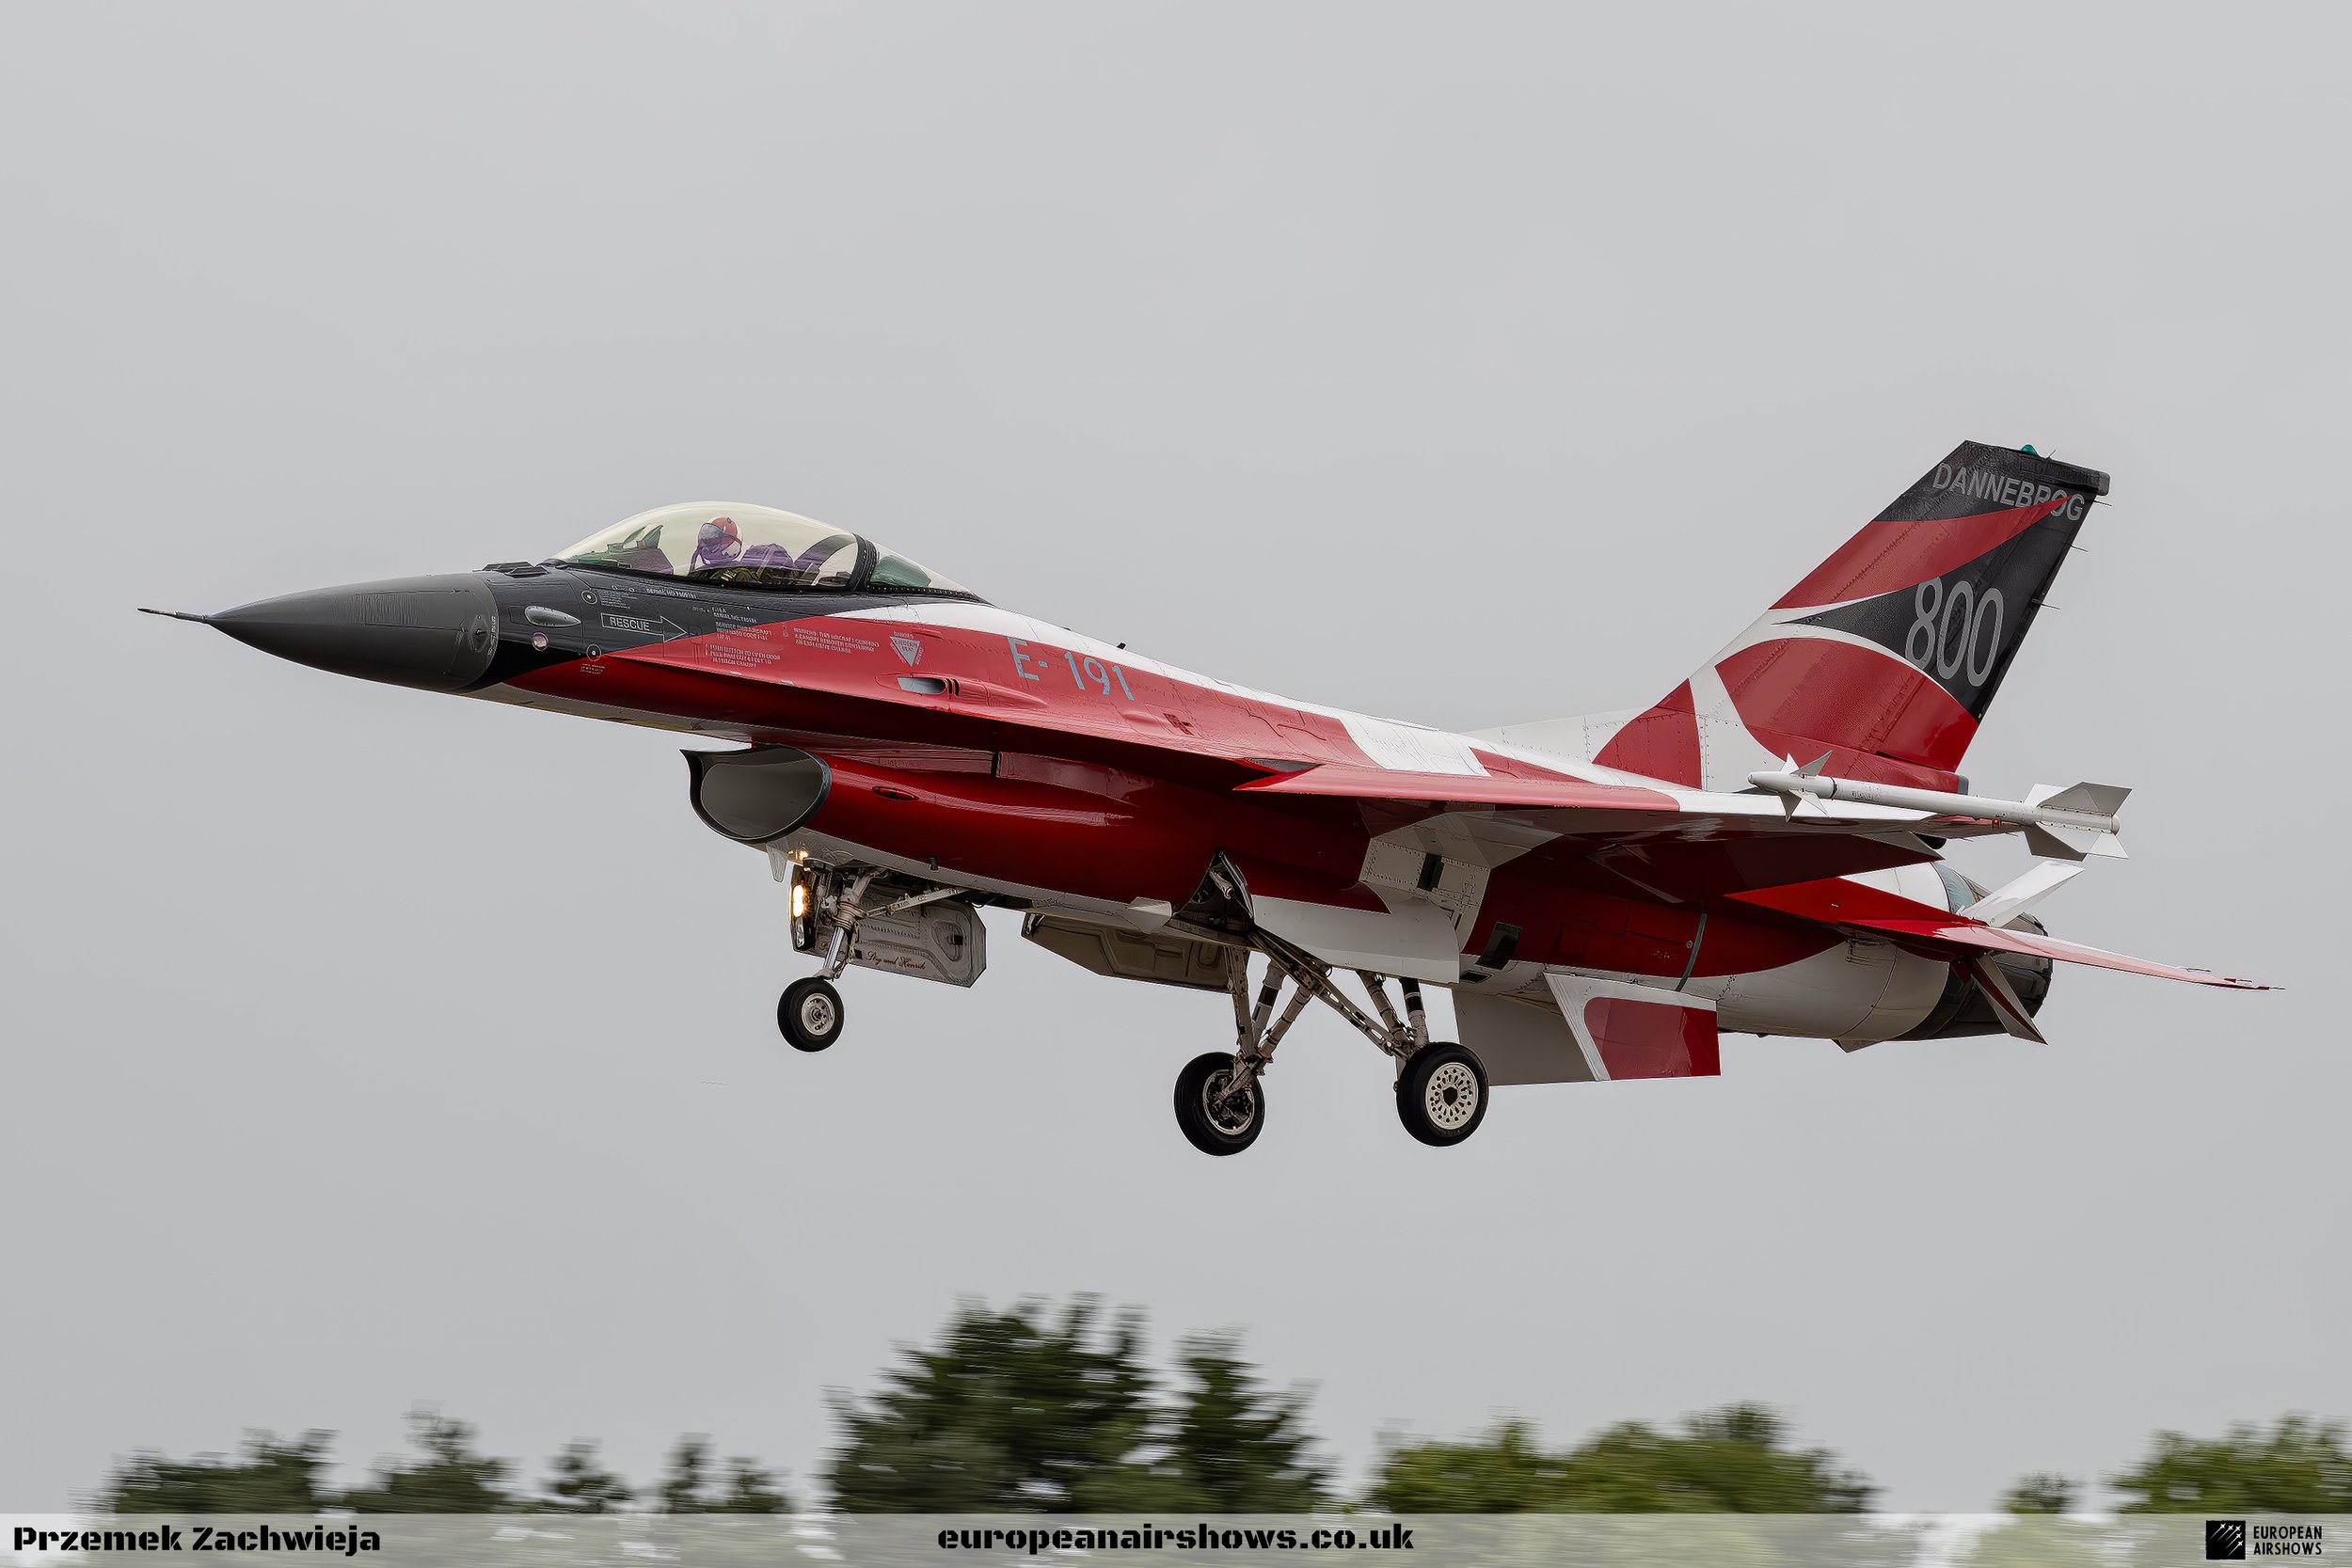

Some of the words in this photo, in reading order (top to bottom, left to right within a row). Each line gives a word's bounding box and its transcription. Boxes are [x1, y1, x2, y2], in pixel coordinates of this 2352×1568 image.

[1932, 463, 2085, 520] DANNEBROG
[609, 616, 650, 631] RESCUE
[1905, 576, 2004, 687] 800
